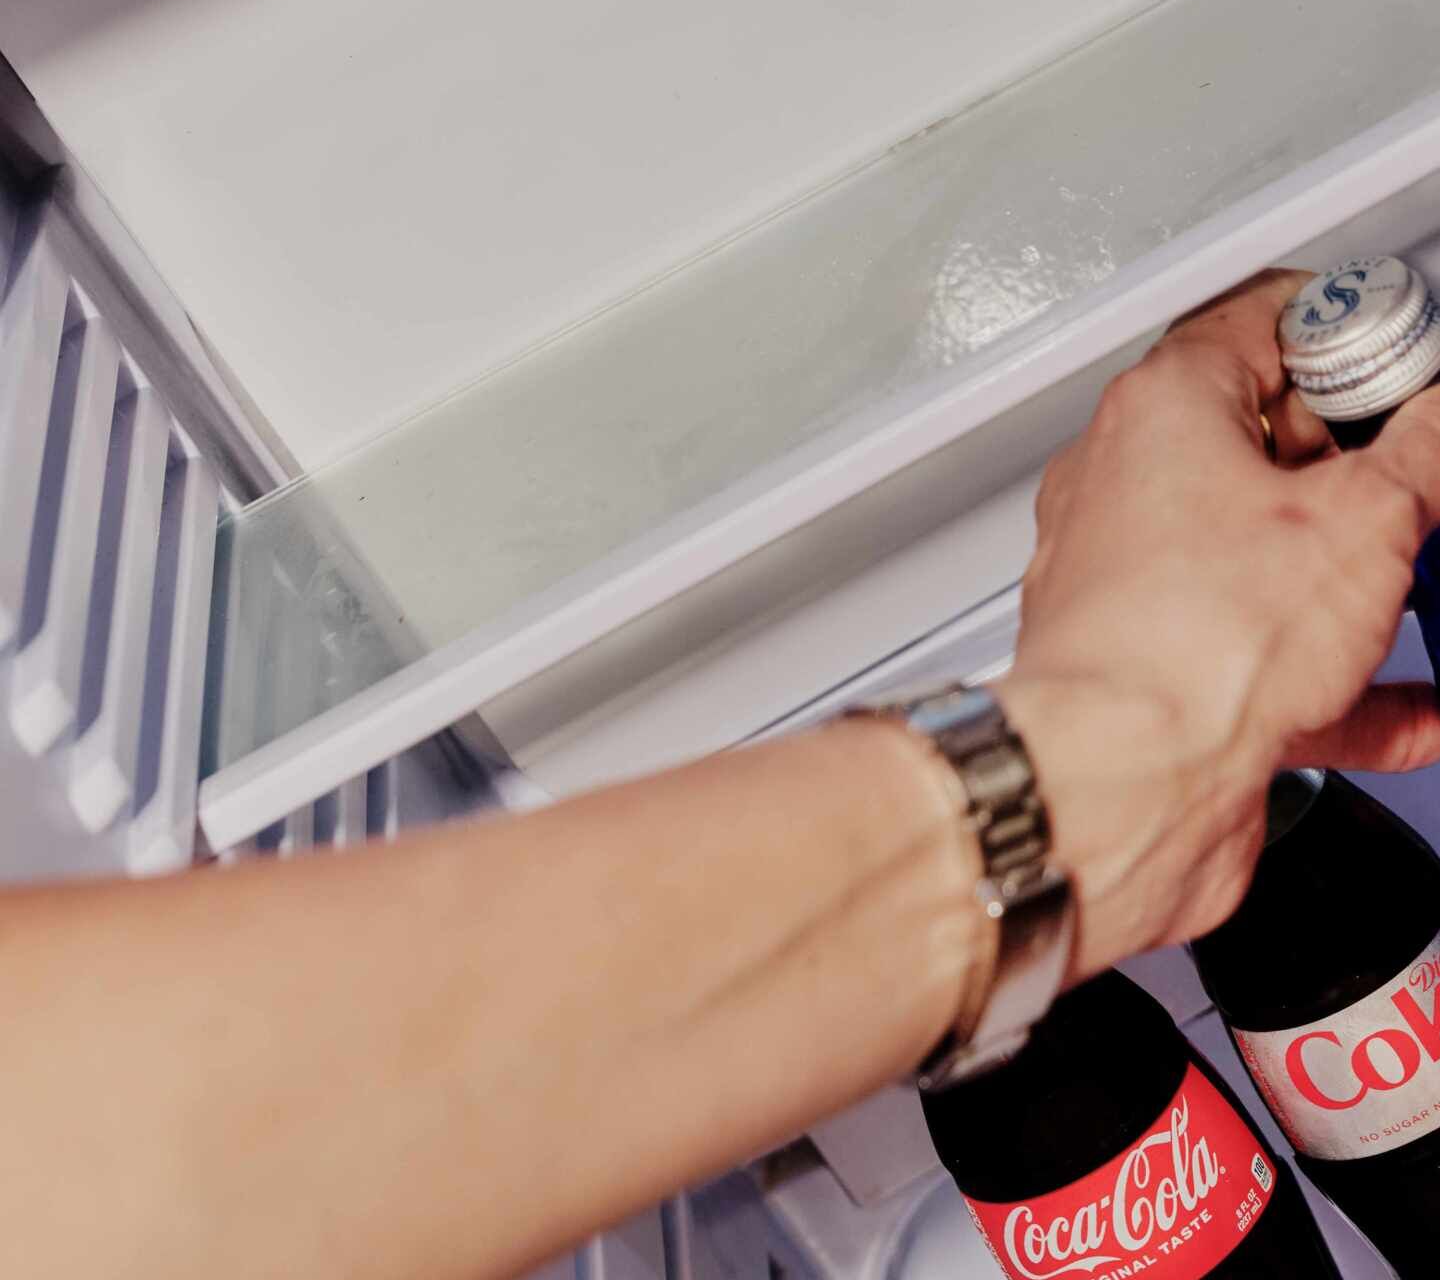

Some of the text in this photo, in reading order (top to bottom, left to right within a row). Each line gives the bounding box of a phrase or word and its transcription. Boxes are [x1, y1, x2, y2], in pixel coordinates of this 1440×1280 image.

[1358, 1130, 1380, 1145] NO
[1383, 1108, 1431, 1138] SUGAR
[1157, 1207, 1214, 1256] TASTE
